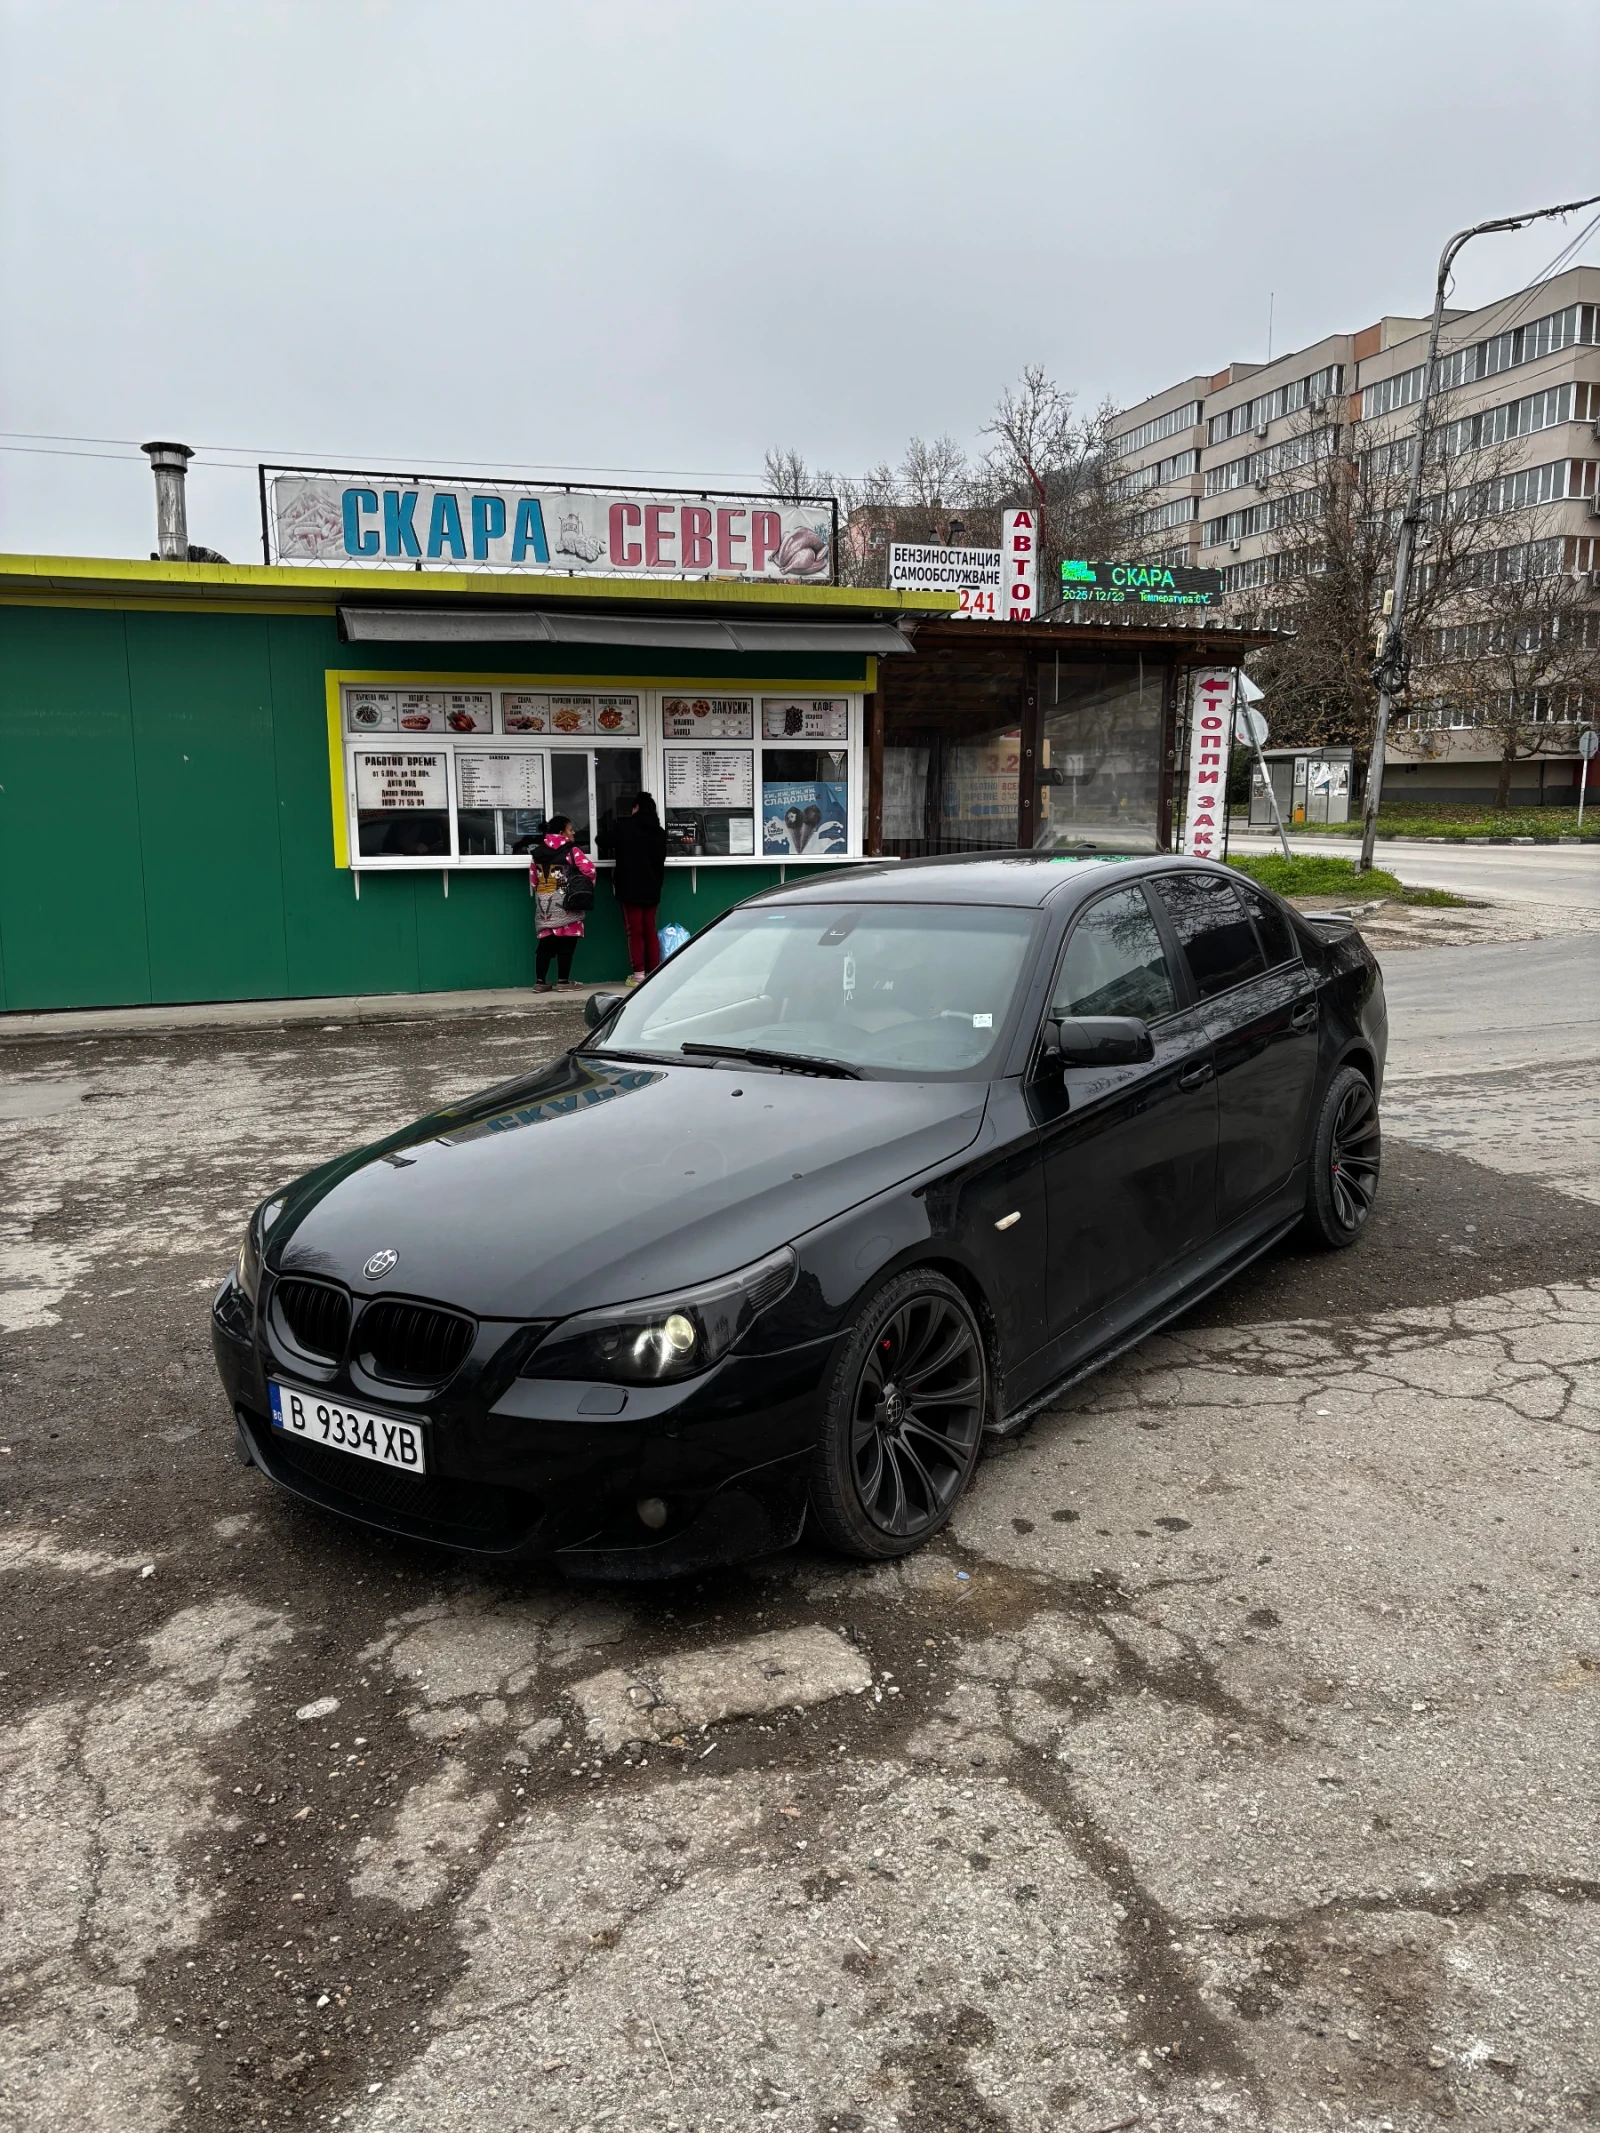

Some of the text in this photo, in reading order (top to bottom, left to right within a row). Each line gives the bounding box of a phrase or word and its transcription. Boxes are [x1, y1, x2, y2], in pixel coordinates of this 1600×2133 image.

[341, 488, 781, 572] СКАРА СЕВЕР
[894, 547, 1001, 569] БЕНЗИНОСТАНЦИЯ
[893, 565, 1000, 585] САМООБСЛУЖВАНЕ
[1111, 567, 1176, 588] СКАРА
[960, 589, 995, 614] 2,41
[812, 701, 834, 712] КАФЕ
[1198, 698, 1223, 784] ТОПЛИ
[364, 756, 438, 767] РАБОТНО ВРЕМЕ
[764, 793, 817, 806] СЛАДОЛЕД
[272, 1409, 284, 1422] BG
[290, 1394, 306, 1431] B
